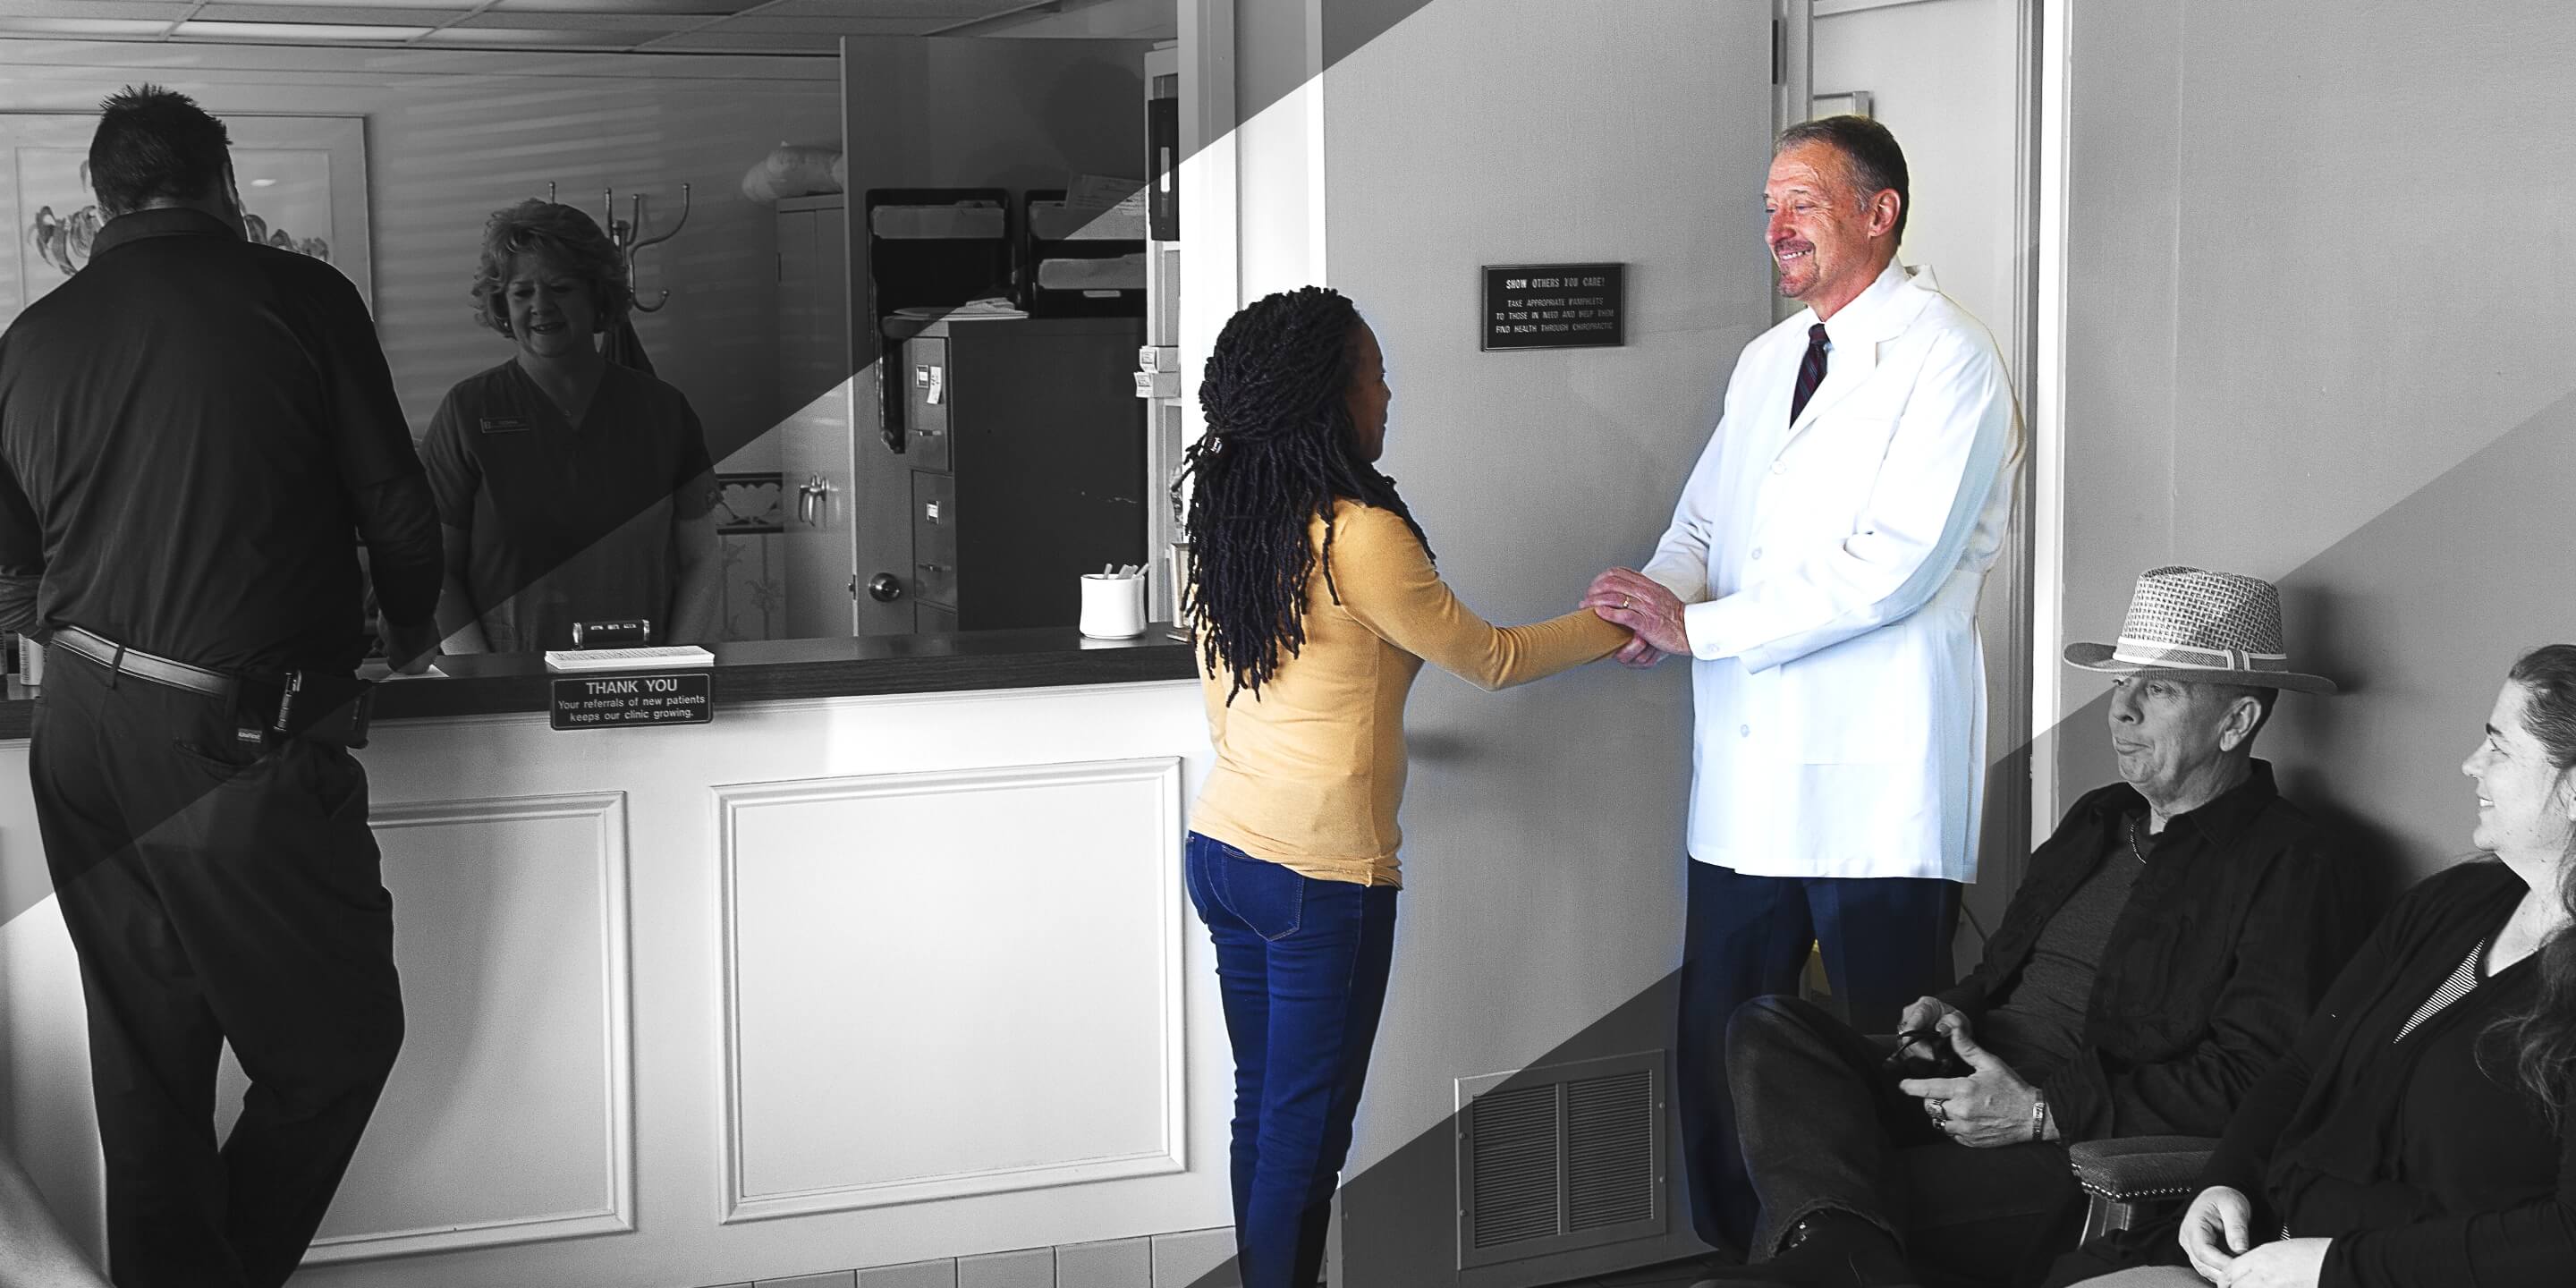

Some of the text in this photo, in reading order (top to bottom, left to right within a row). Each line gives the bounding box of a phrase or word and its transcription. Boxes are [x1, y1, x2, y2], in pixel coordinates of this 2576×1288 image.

[1505, 276, 1606, 289] SHOW OTHERS YOU CARE!
[1507, 297, 1604, 308] TAKE APPROPRIATE PAMPHLETS
[1496, 312, 1504, 321] TO
[1509, 311, 1528, 320] THOSE
[1531, 311, 1539, 319] IN
[1542, 310, 1559, 319] NEED
[1562, 310, 1575, 318] AND
[1579, 309, 1594, 318] HELP
[1496, 322, 1614, 334] FIND HEALTH THROUGH CHIROPRACTIC
[586, 678, 678, 695] THANK YOU
[558, 694, 706, 709] Your referrals of new patients
[570, 708, 694, 723] keeps our clinic growing.
